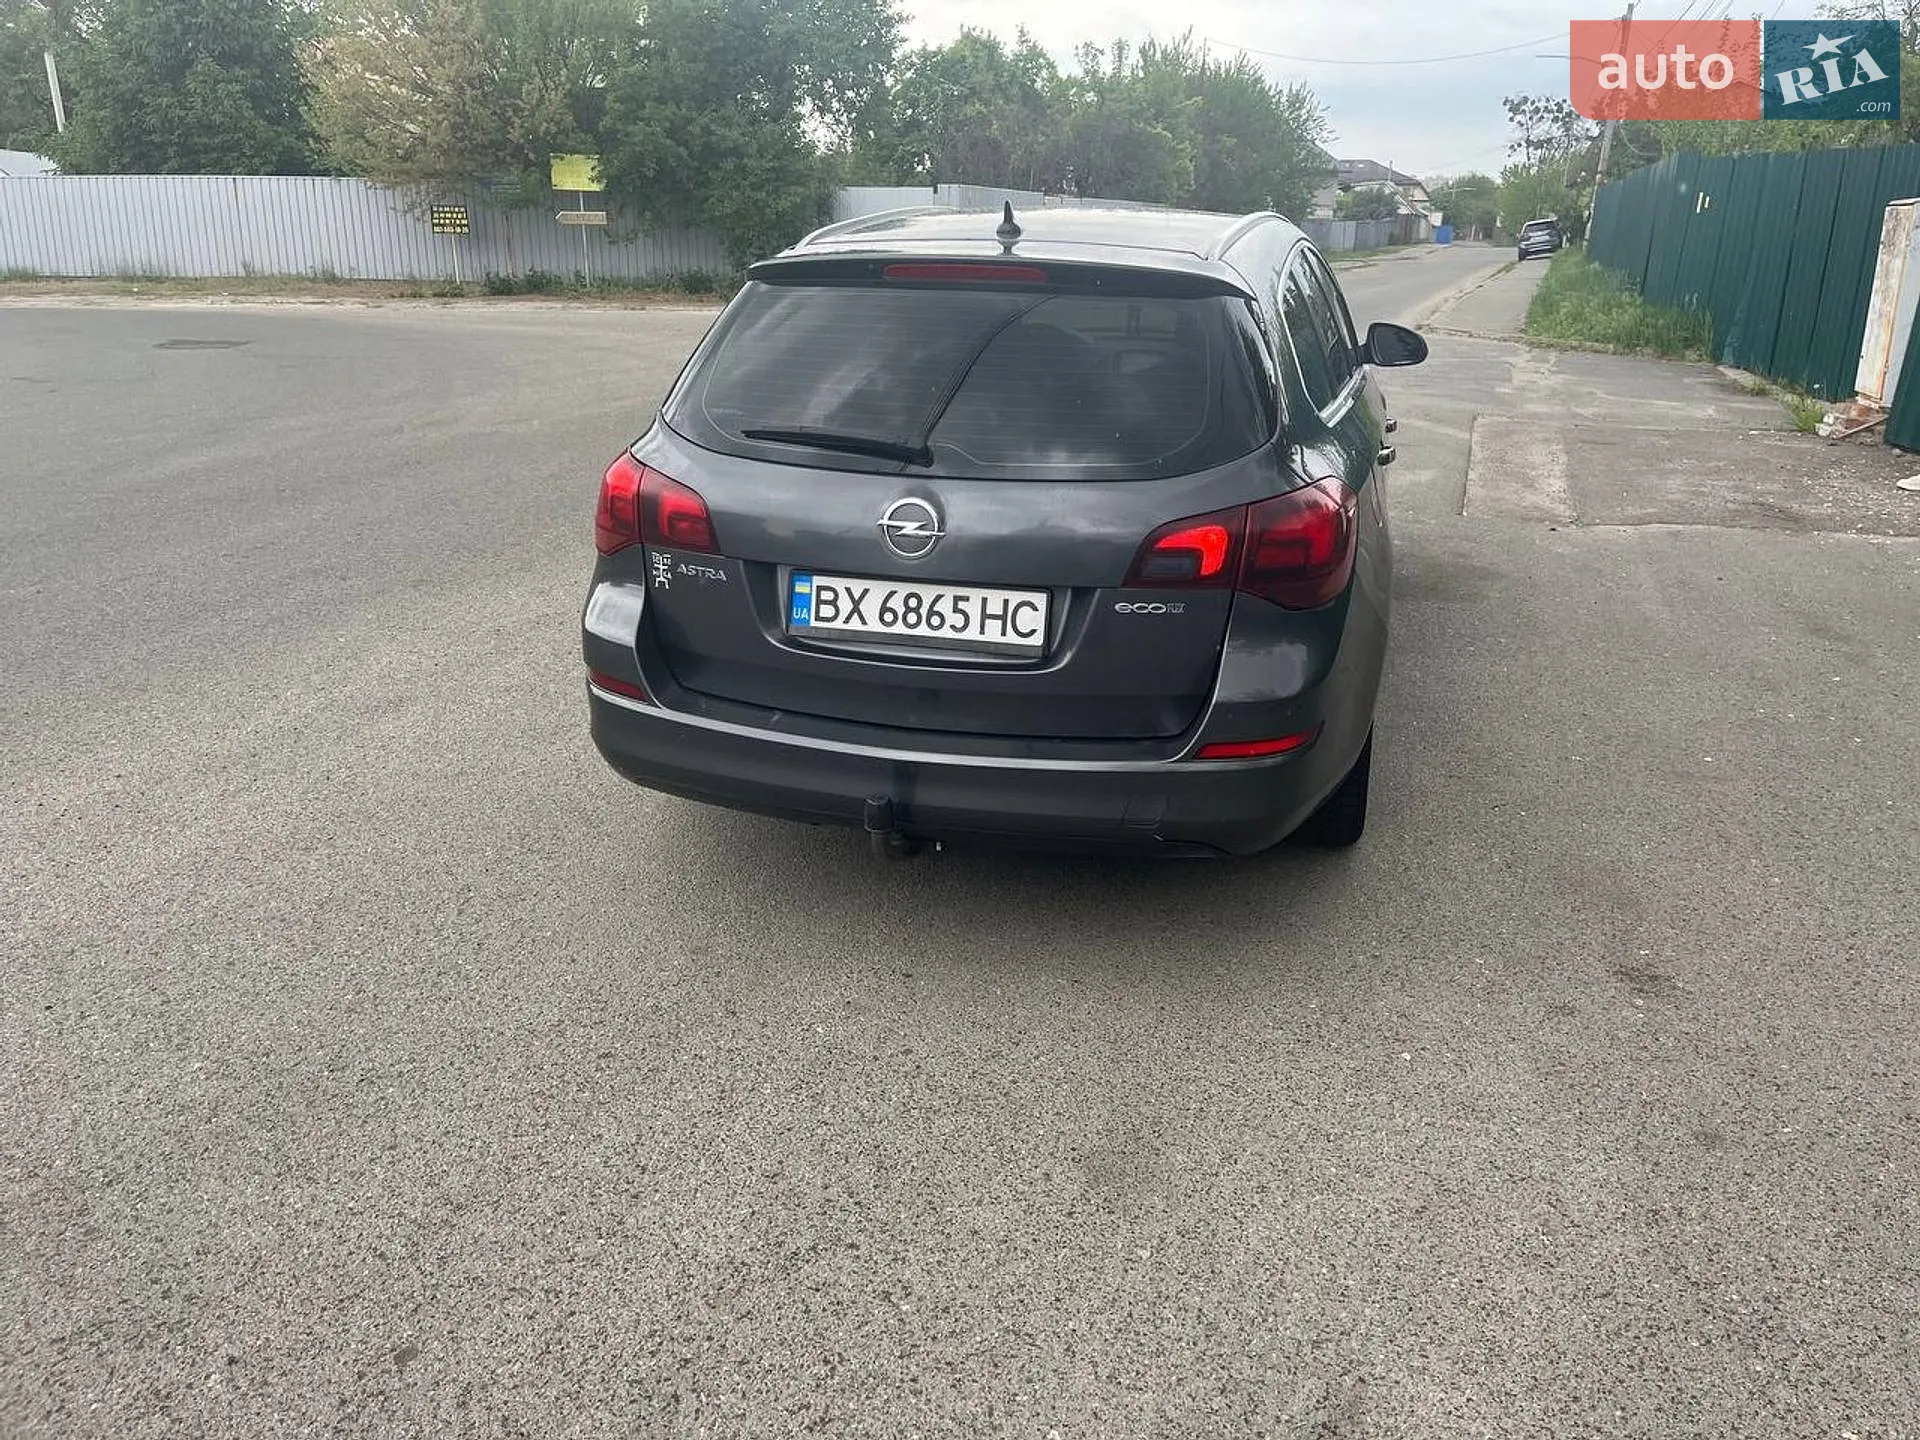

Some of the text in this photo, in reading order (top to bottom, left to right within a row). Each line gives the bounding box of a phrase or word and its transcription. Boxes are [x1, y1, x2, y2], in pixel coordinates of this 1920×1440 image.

[676, 563, 728, 582] ASTRA
[793, 607, 809, 620] UA
[814, 585, 1040, 639] BX 6865 HC
